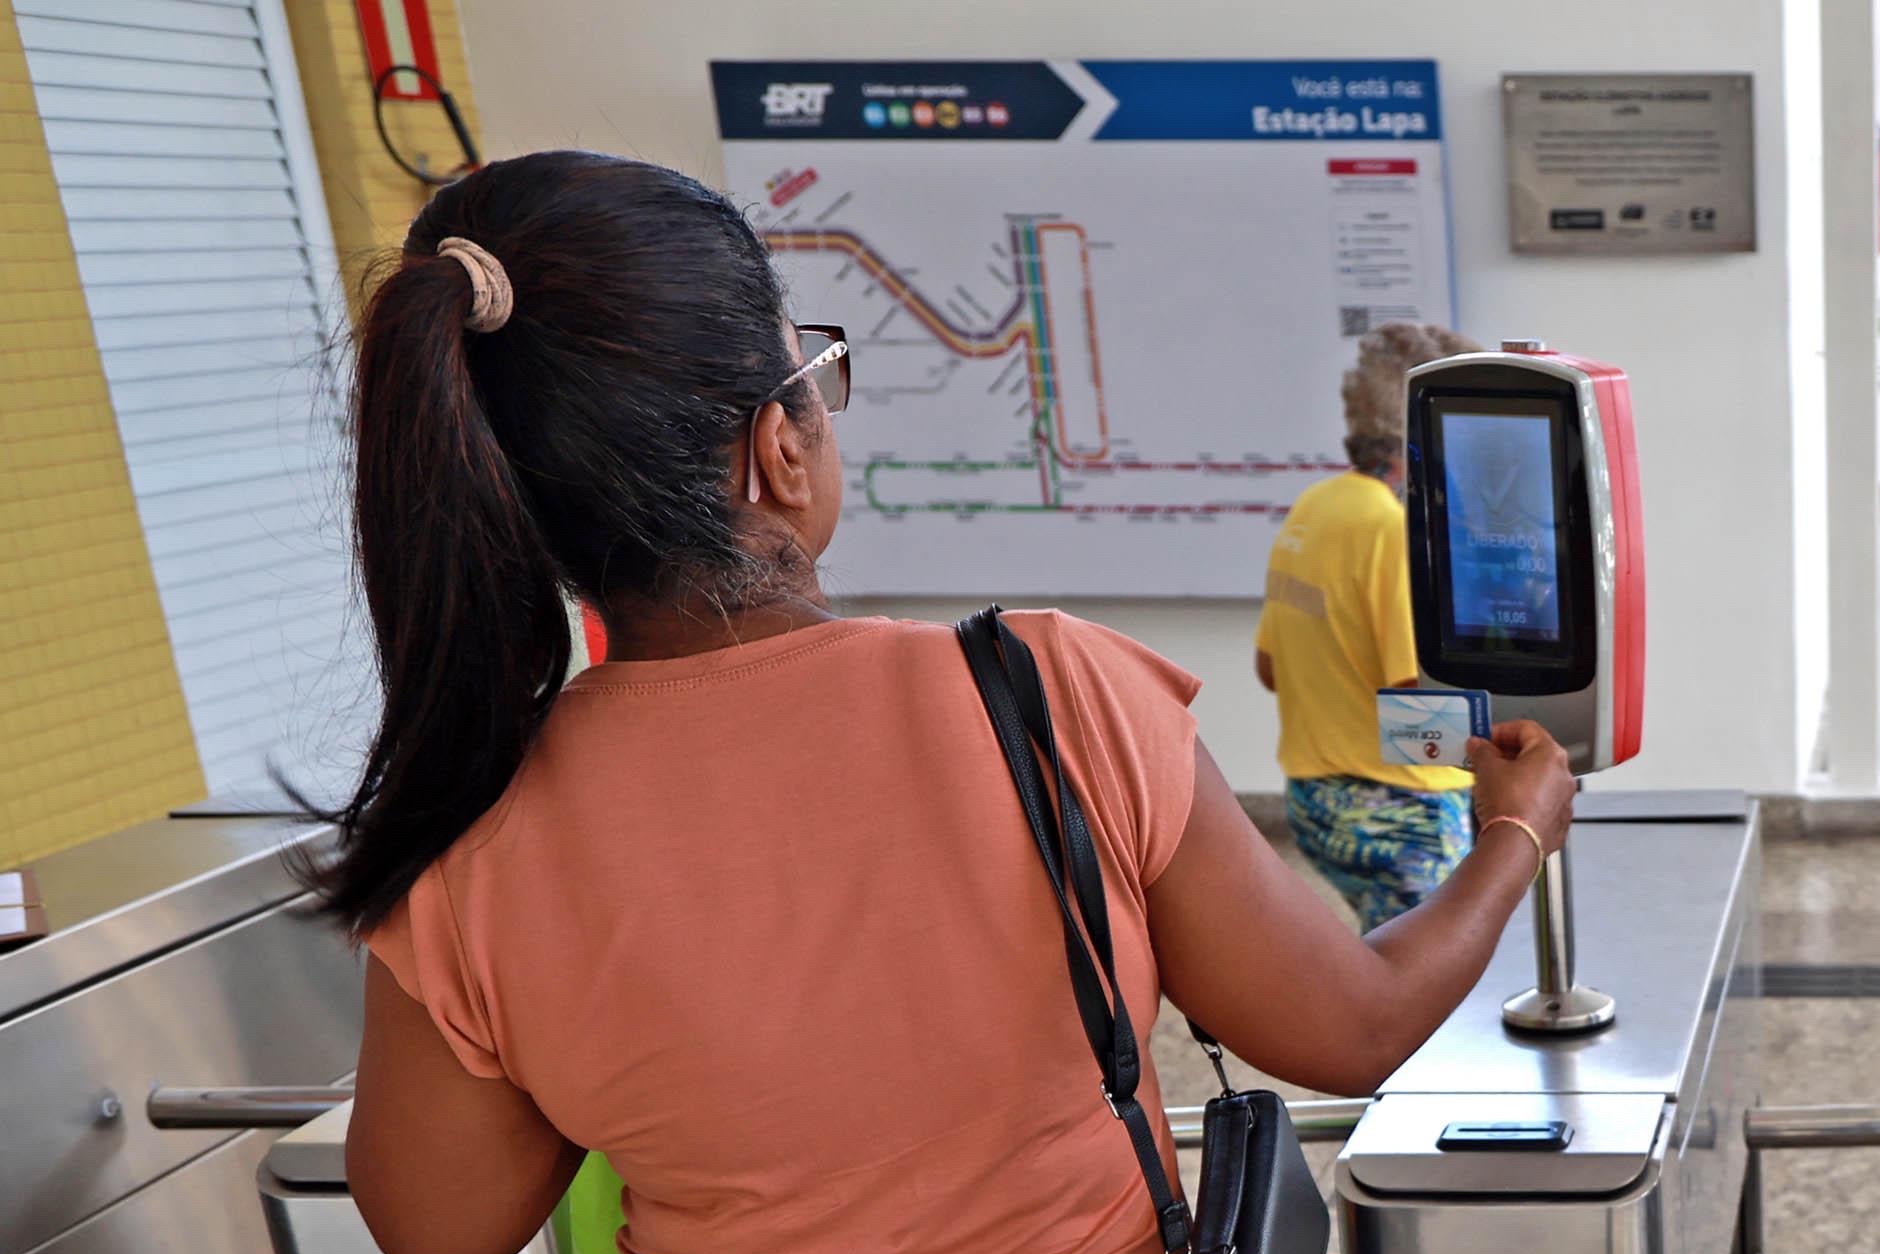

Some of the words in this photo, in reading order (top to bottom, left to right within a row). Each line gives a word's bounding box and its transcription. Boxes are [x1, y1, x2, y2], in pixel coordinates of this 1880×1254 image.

[762, 83, 834, 115] BRT
[1291, 76, 1341, 98] Você
[1346, 76, 1389, 98] está
[1392, 79, 1423, 98] na:
[1252, 105, 1358, 137] Estação
[1361, 105, 1427, 137] Lapa
[1467, 532, 1538, 549] LIBERADO
